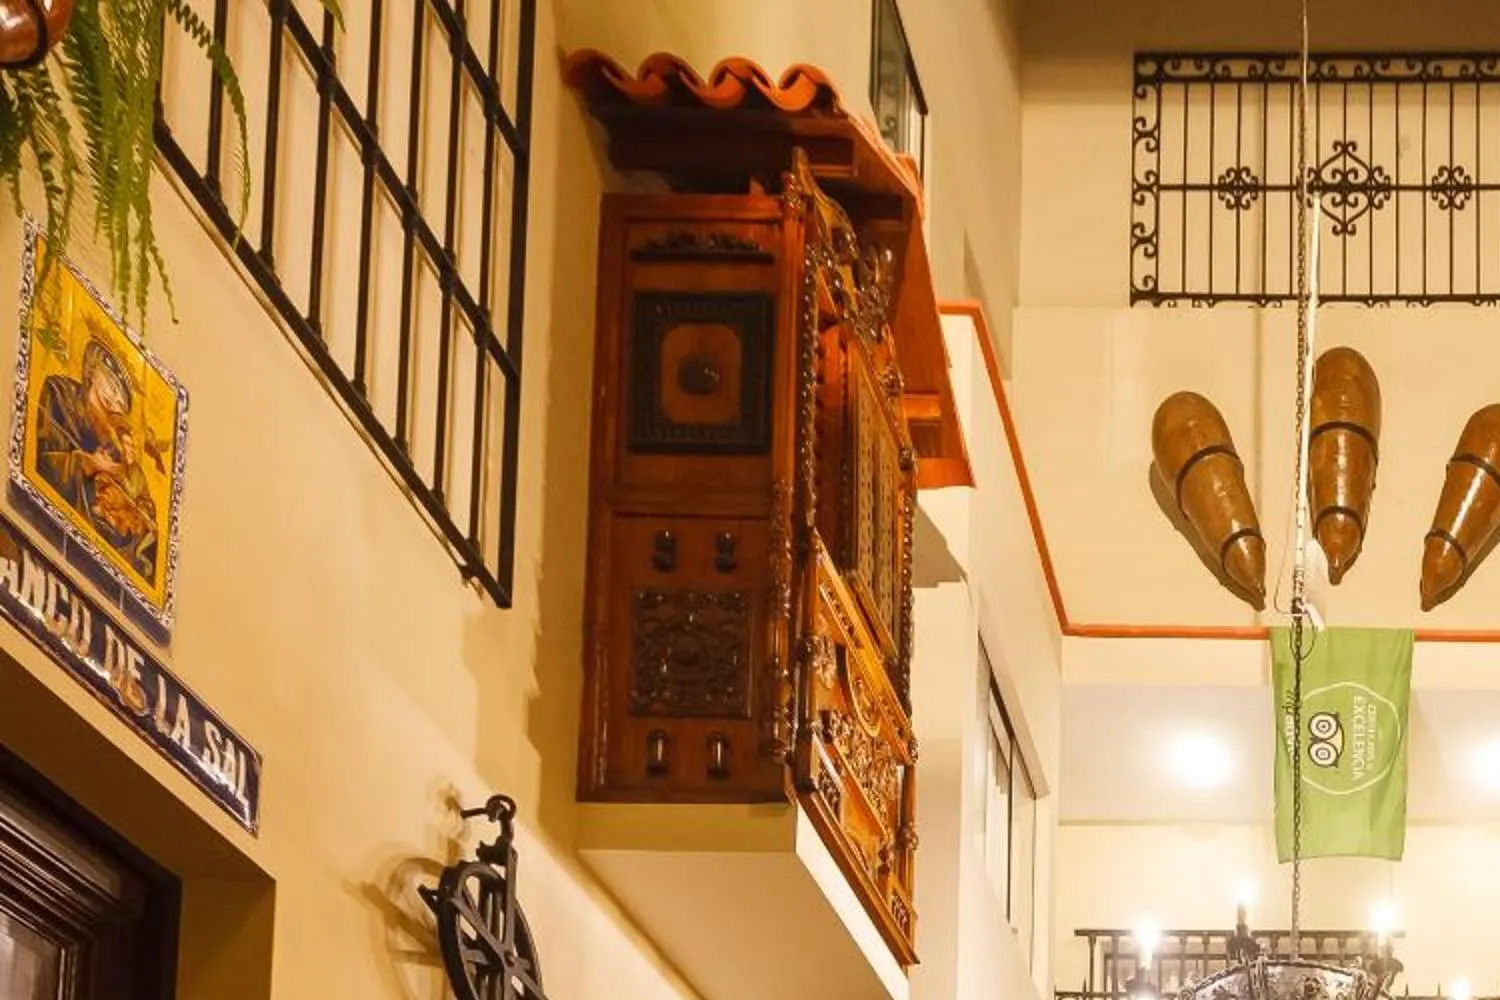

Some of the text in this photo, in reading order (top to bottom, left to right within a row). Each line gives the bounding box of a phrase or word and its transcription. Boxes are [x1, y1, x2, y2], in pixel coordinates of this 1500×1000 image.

[154, 673, 191, 752] LA
[201, 718, 250, 806] SAL
[1353, 695, 1366, 781] EXCELENCIA
